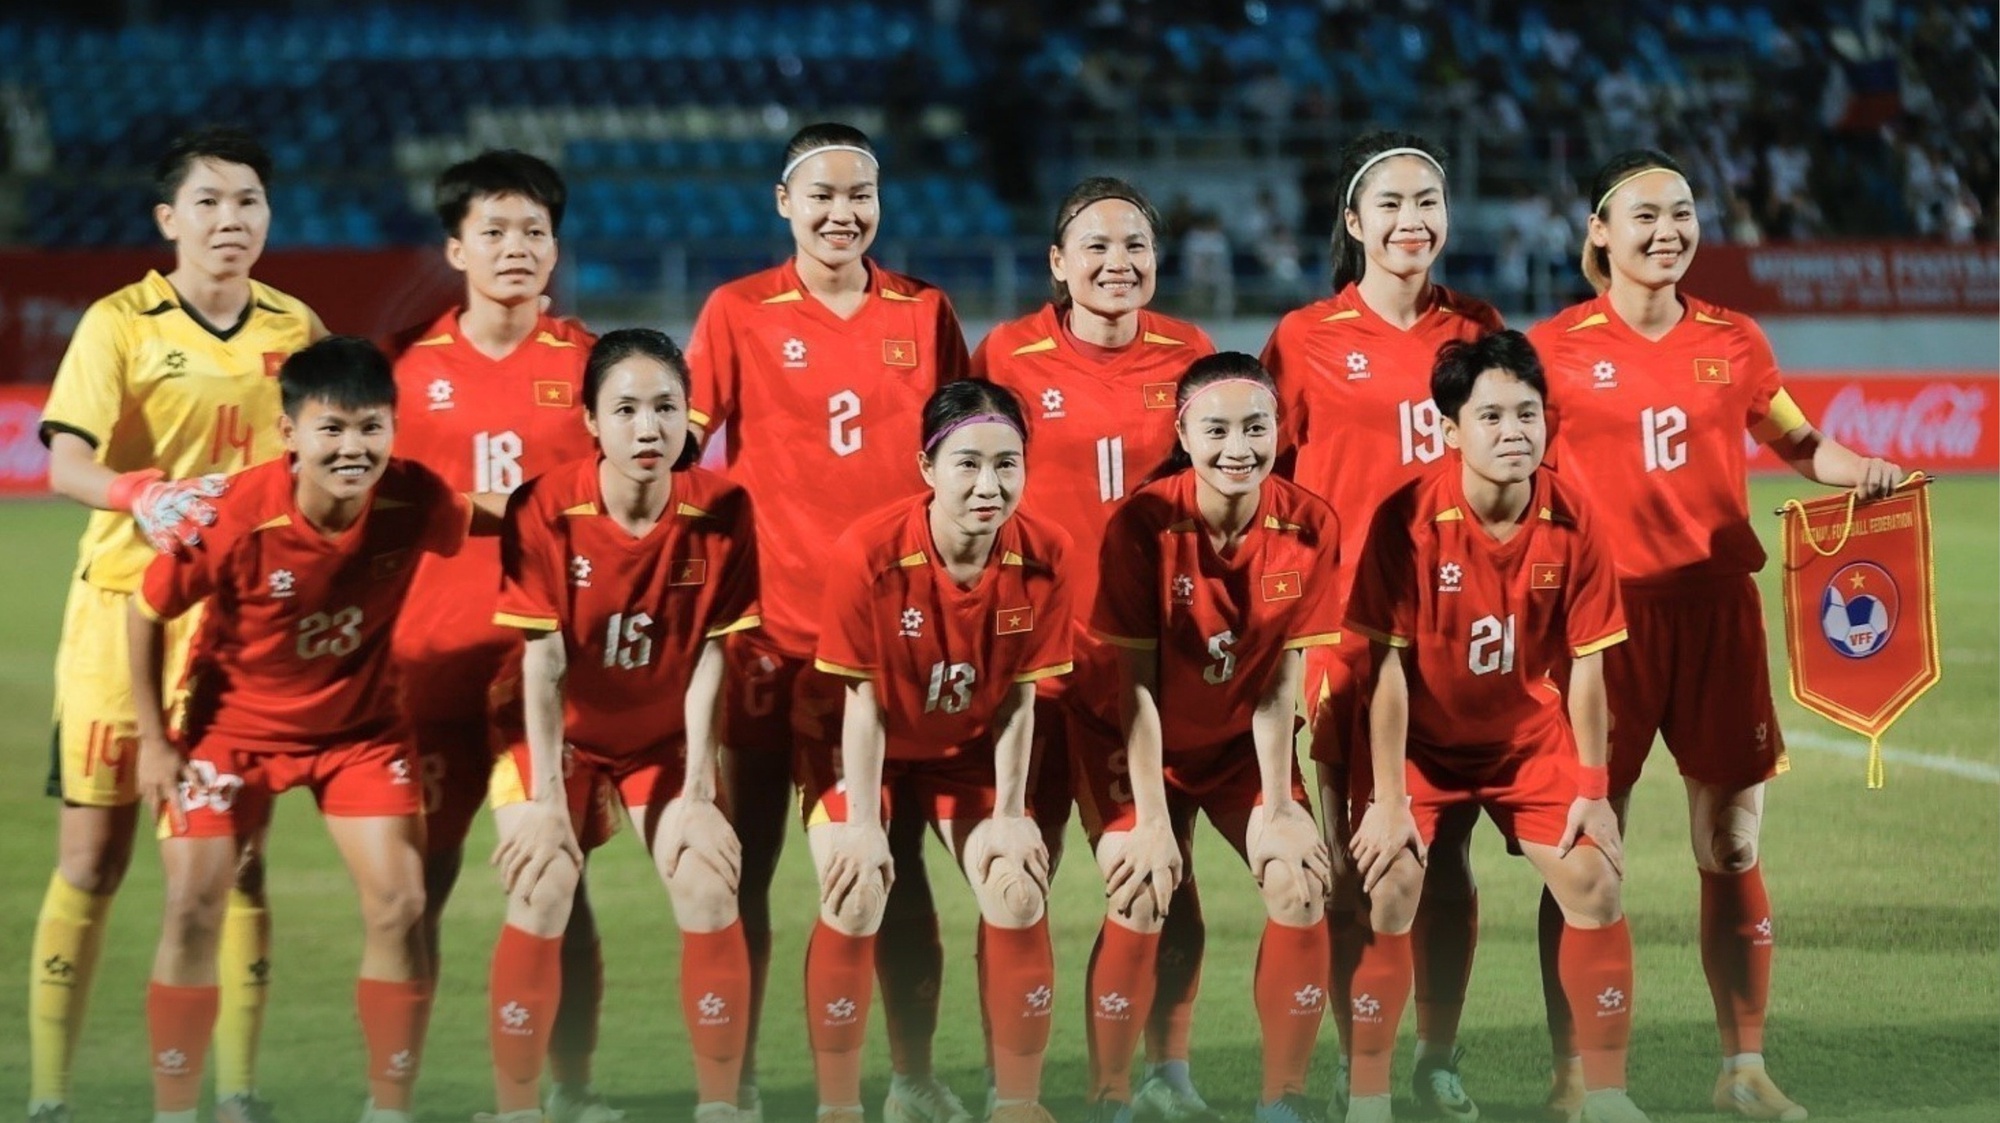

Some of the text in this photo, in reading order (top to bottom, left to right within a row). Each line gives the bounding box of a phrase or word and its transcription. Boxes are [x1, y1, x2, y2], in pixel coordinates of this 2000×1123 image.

[210, 404, 255, 468] 14
[828, 389, 863, 457] 2
[1399, 397, 1445, 466] 19
[1641, 404, 1688, 473] 12
[473, 430, 523, 494] 18
[1096, 434, 1124, 504] 11
[296, 606, 364, 660] 23
[603, 612, 654, 670] 15
[1203, 630, 1236, 685] 5
[1468, 613, 1515, 676] 21
[1849, 631, 1873, 646] VFF
[924, 660, 976, 714] 13
